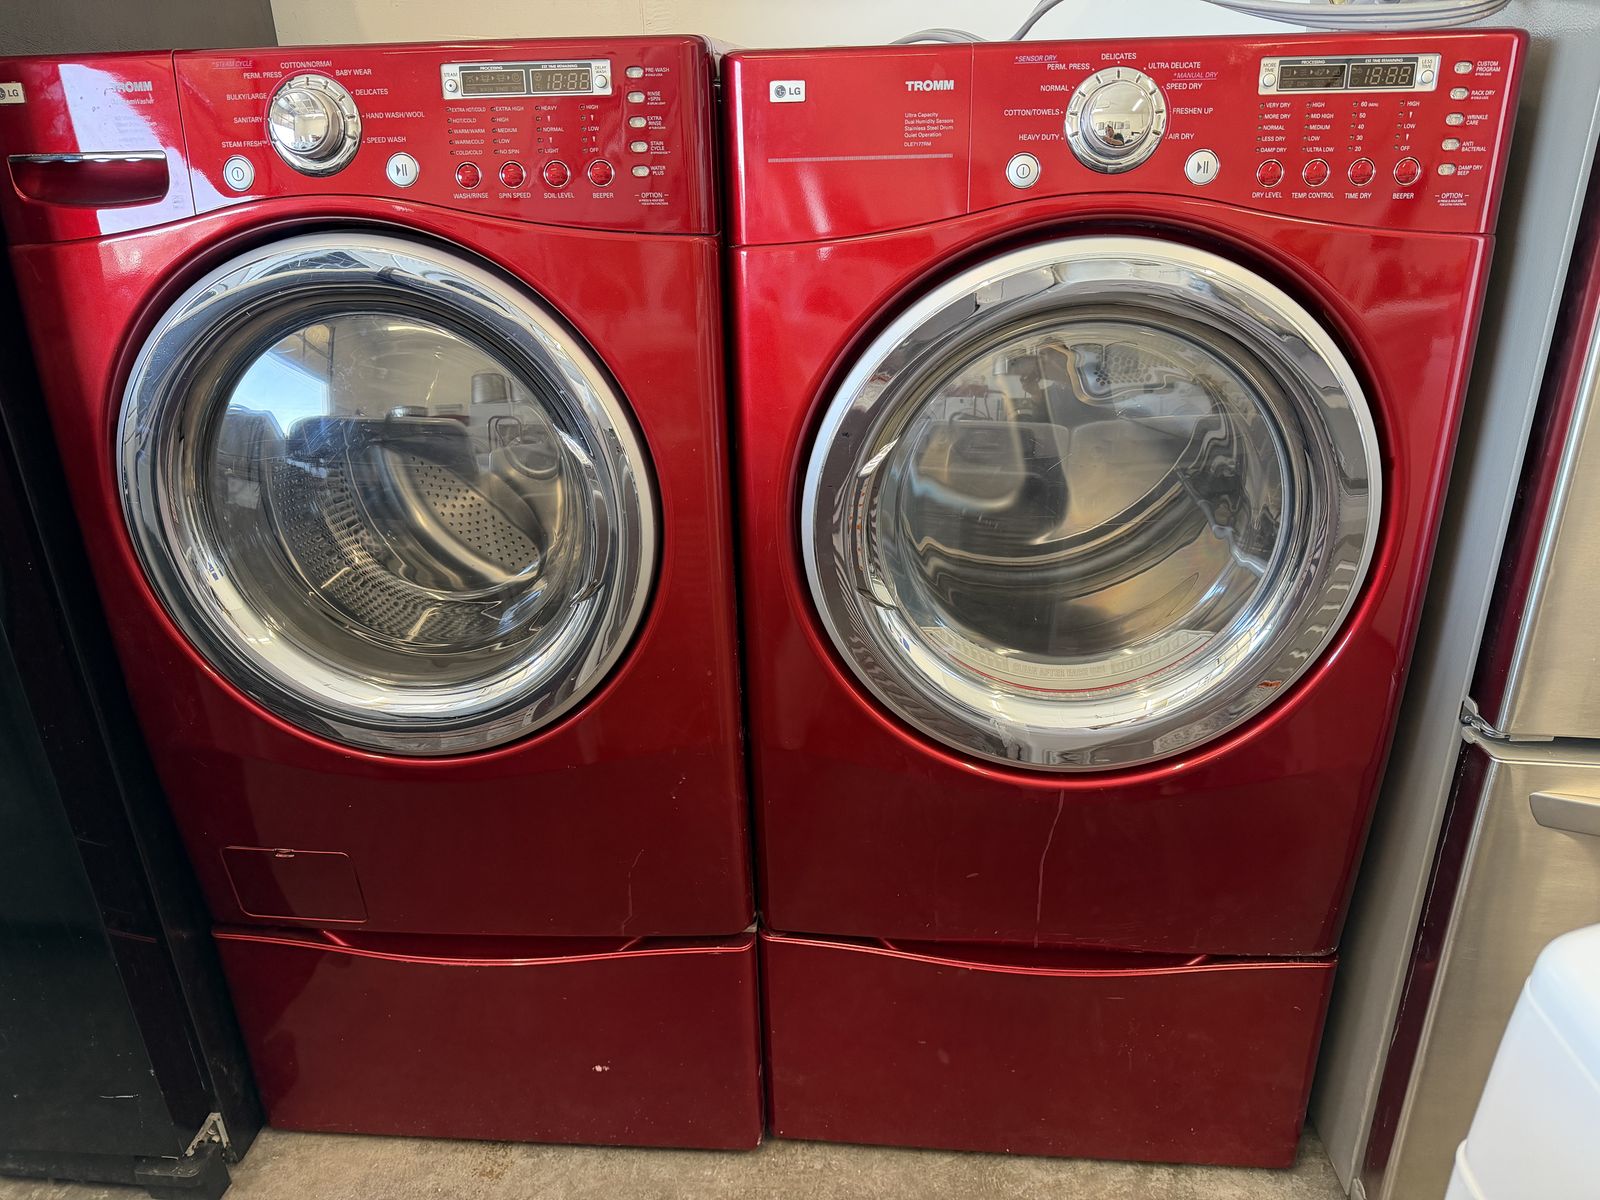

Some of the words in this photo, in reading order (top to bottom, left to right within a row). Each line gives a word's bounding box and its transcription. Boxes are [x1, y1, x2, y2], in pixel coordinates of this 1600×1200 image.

[905, 80, 954, 91] TROMM
[7, 89, 19, 97] LG
[789, 87, 801, 95] LG
[226, 93, 267, 101] BULKY/LARGE
